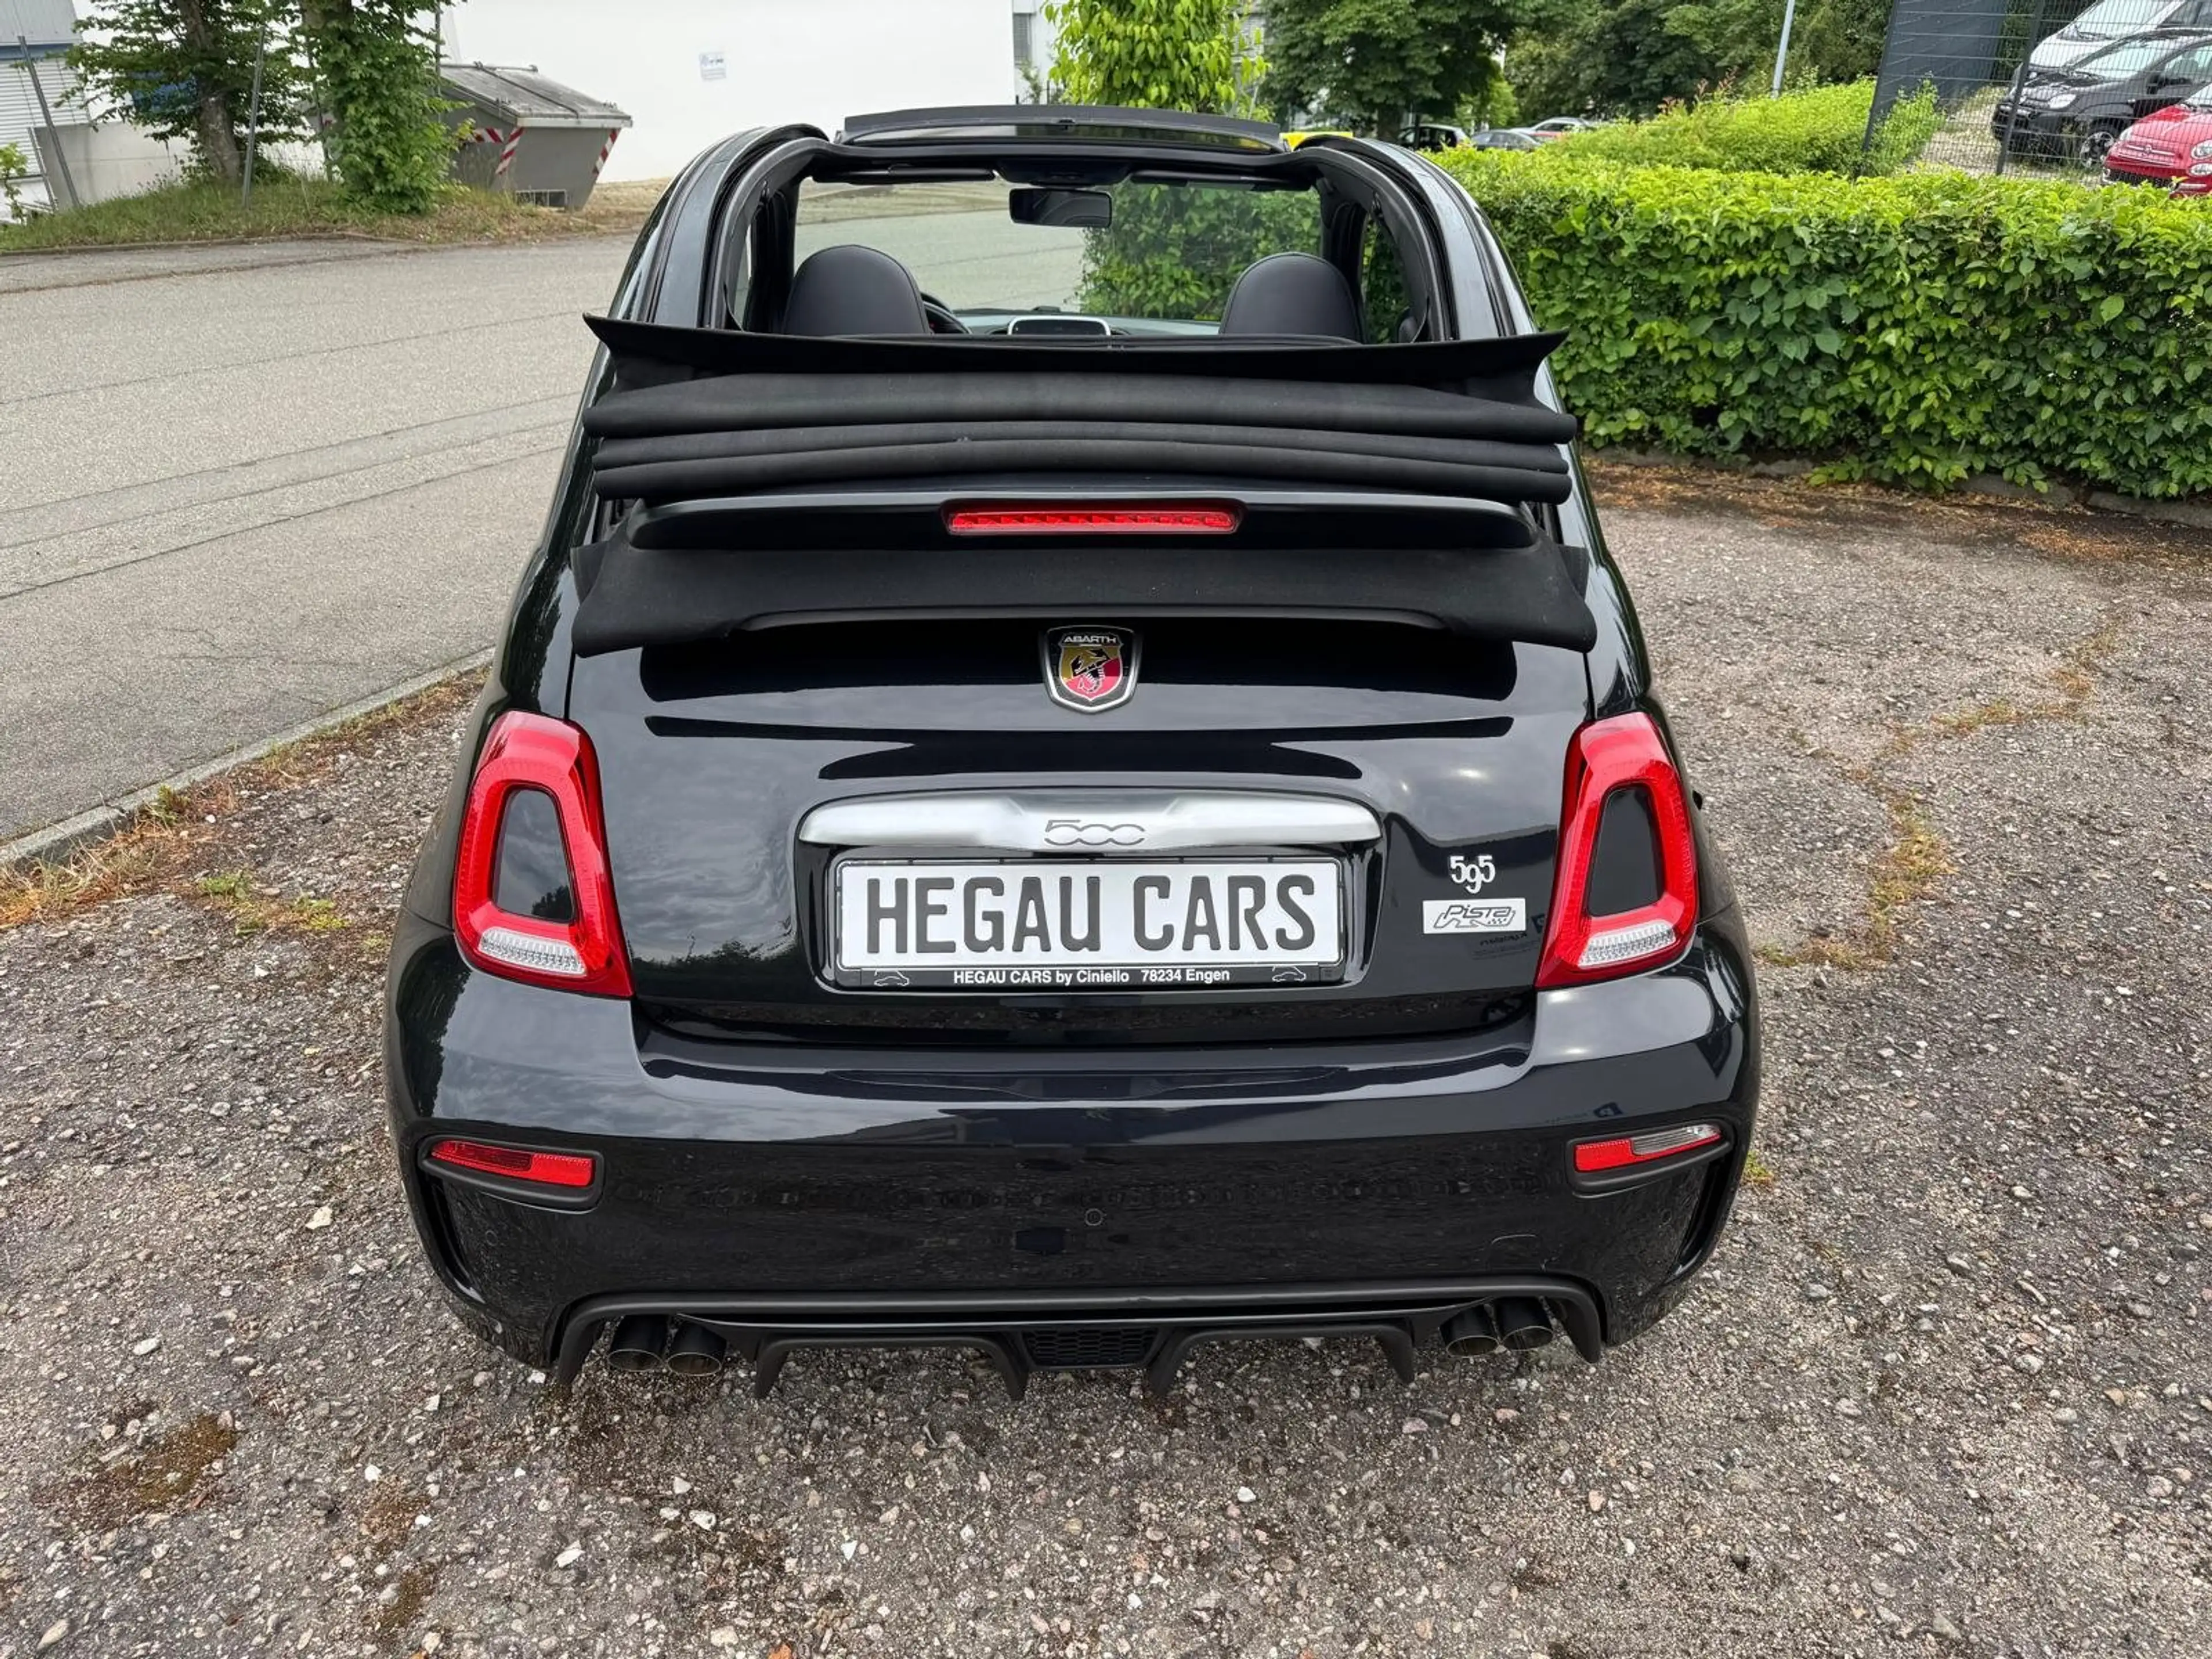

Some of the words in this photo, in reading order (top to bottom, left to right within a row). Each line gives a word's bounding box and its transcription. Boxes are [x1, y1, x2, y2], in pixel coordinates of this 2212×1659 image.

[1044, 819, 1145, 846] 500
[1449, 855, 1496, 894] 595
[866, 876, 1101, 955] HEGAU
[1133, 874, 1316, 952] CARS
[953, 970, 1006, 984] HEGAU
[1010, 970, 1052, 984] CARS
[1056, 970, 1073, 986] by
[1076, 969, 1130, 983] Ciniello
[1141, 969, 1182, 982] 78234
[1185, 969, 1230, 984] Engen
